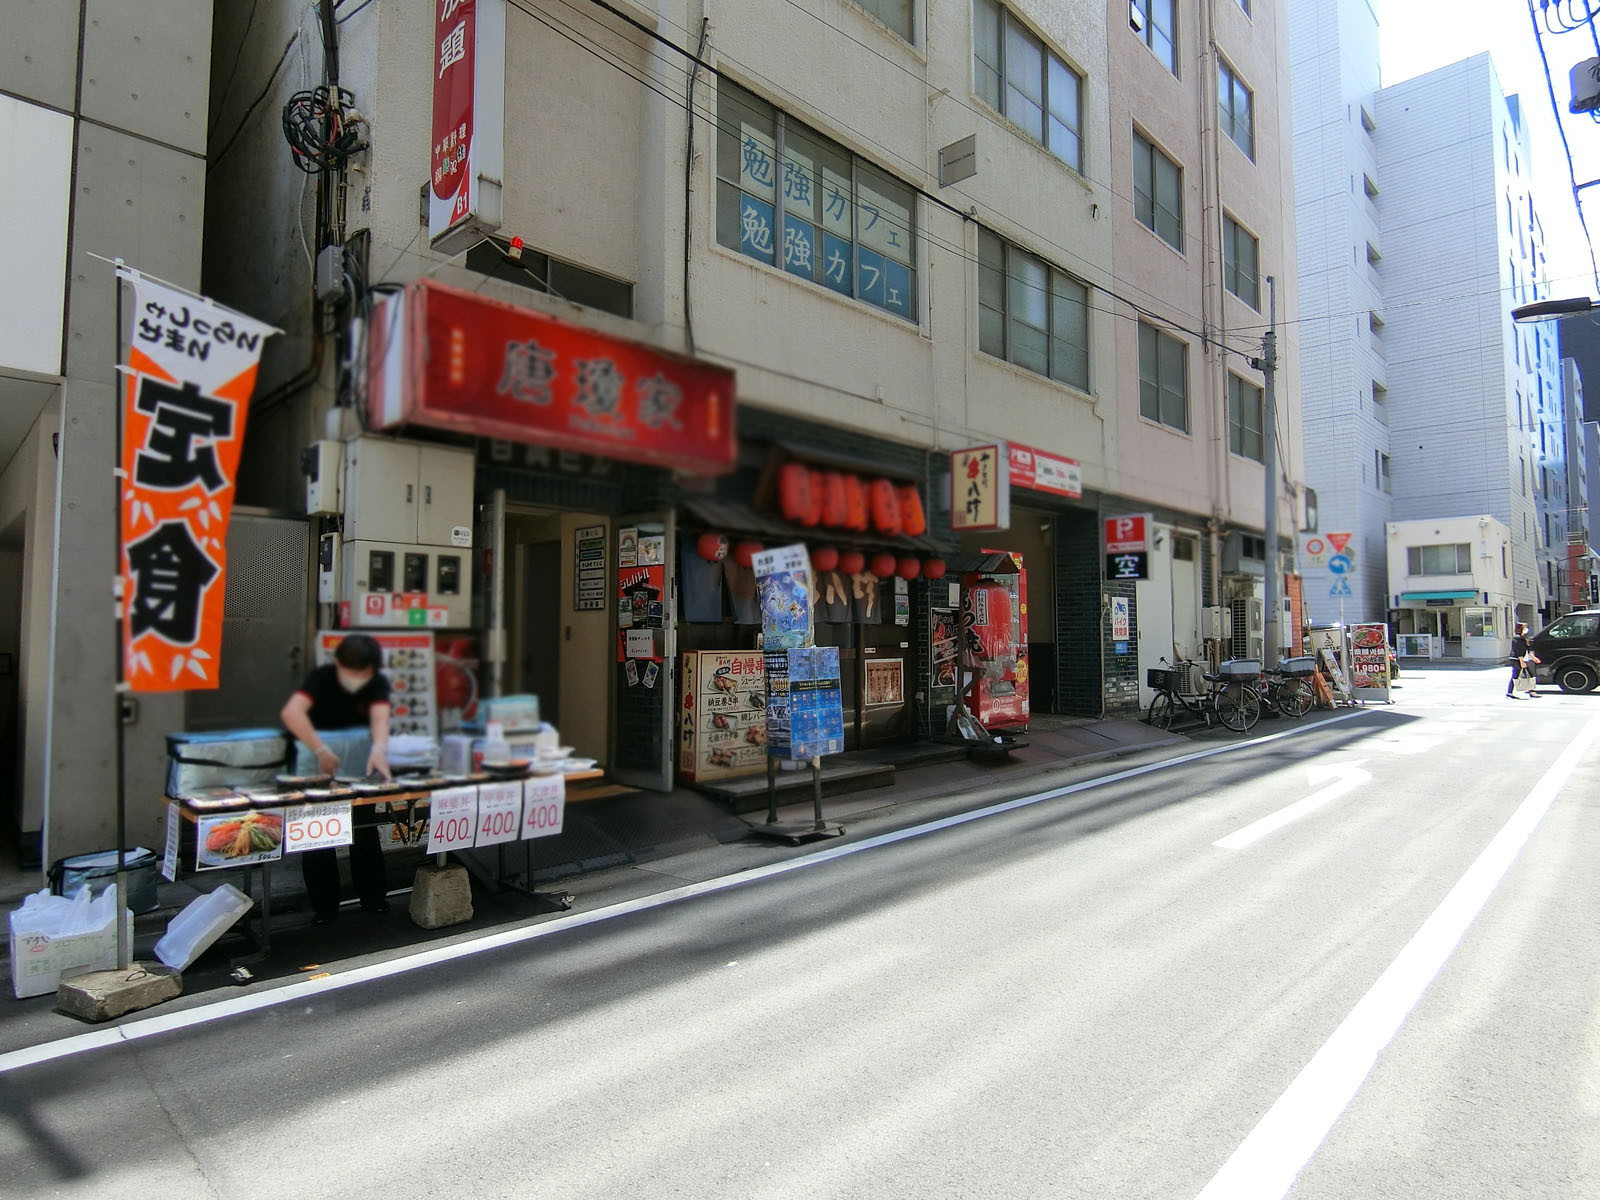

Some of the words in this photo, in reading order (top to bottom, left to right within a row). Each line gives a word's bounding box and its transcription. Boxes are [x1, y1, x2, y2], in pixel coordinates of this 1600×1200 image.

[457, 191, 468, 215] B1
[742, 137, 901, 249] 勉強カフェ
[742, 205, 902, 306] 勉強カフェ
[1114, 554, 1140, 579] 空
[1114, 617, 1127, 626] バイク
[481, 810, 515, 837] 400
[527, 804, 559, 829] 400
[289, 818, 342, 842] 500
[433, 817, 470, 844] 400
